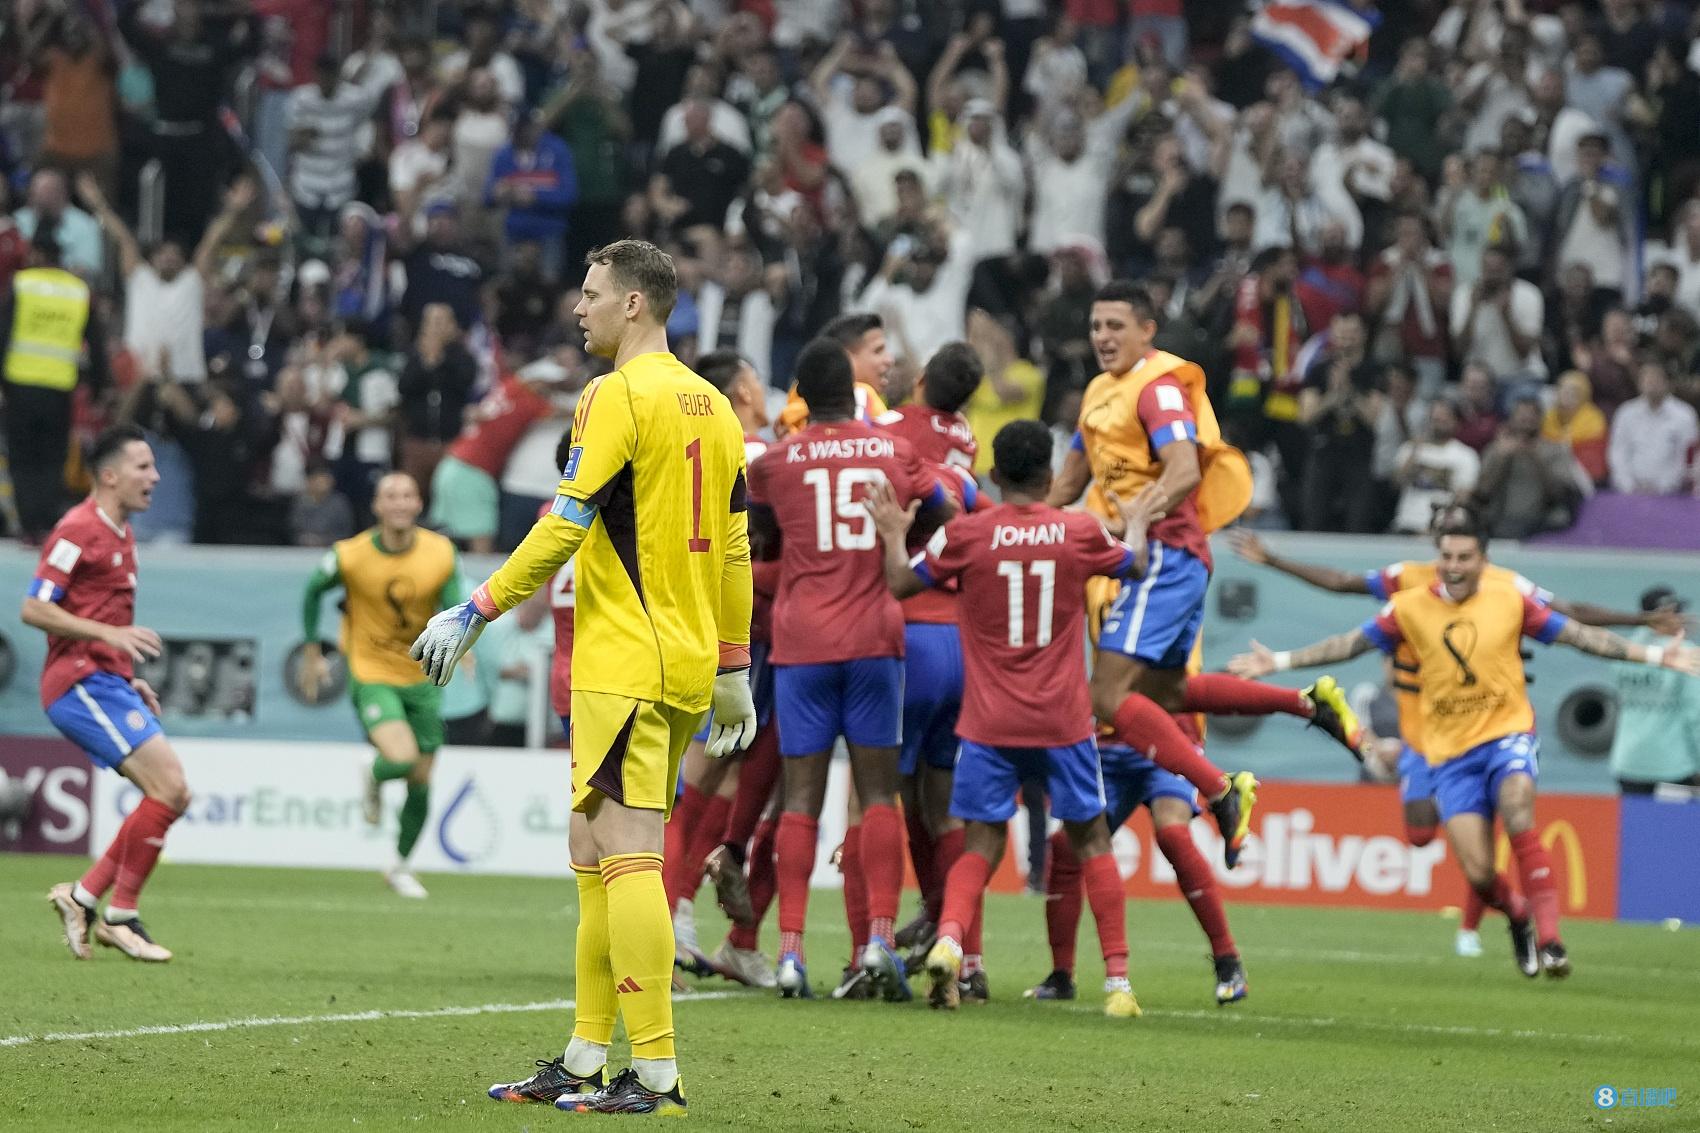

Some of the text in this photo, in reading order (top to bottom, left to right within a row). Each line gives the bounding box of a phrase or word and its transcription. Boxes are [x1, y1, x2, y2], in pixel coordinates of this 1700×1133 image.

[677, 393, 714, 416] NEUER
[786, 437, 895, 464] K. WASTON
[685, 437, 711, 553] 1
[990, 522, 1066, 550] JOHAN
[997, 560, 1056, 648] 11
